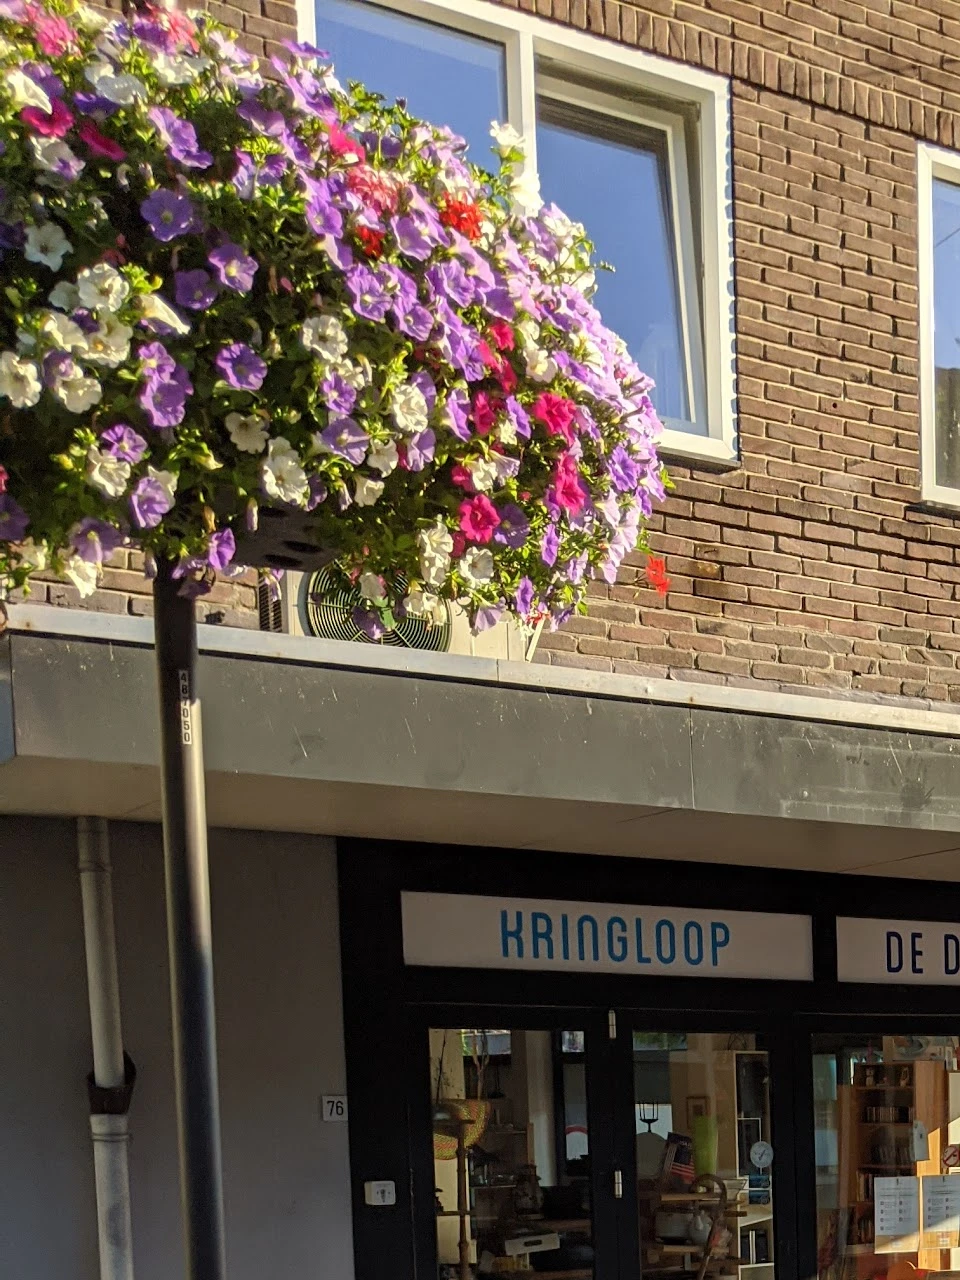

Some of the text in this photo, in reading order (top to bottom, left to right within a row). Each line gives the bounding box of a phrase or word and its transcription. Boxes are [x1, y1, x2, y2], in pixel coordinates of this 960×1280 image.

[499, 909, 731, 967] KRINGLOOP
[886, 931, 924, 974] DE
[326, 1100, 344, 1116] 76
